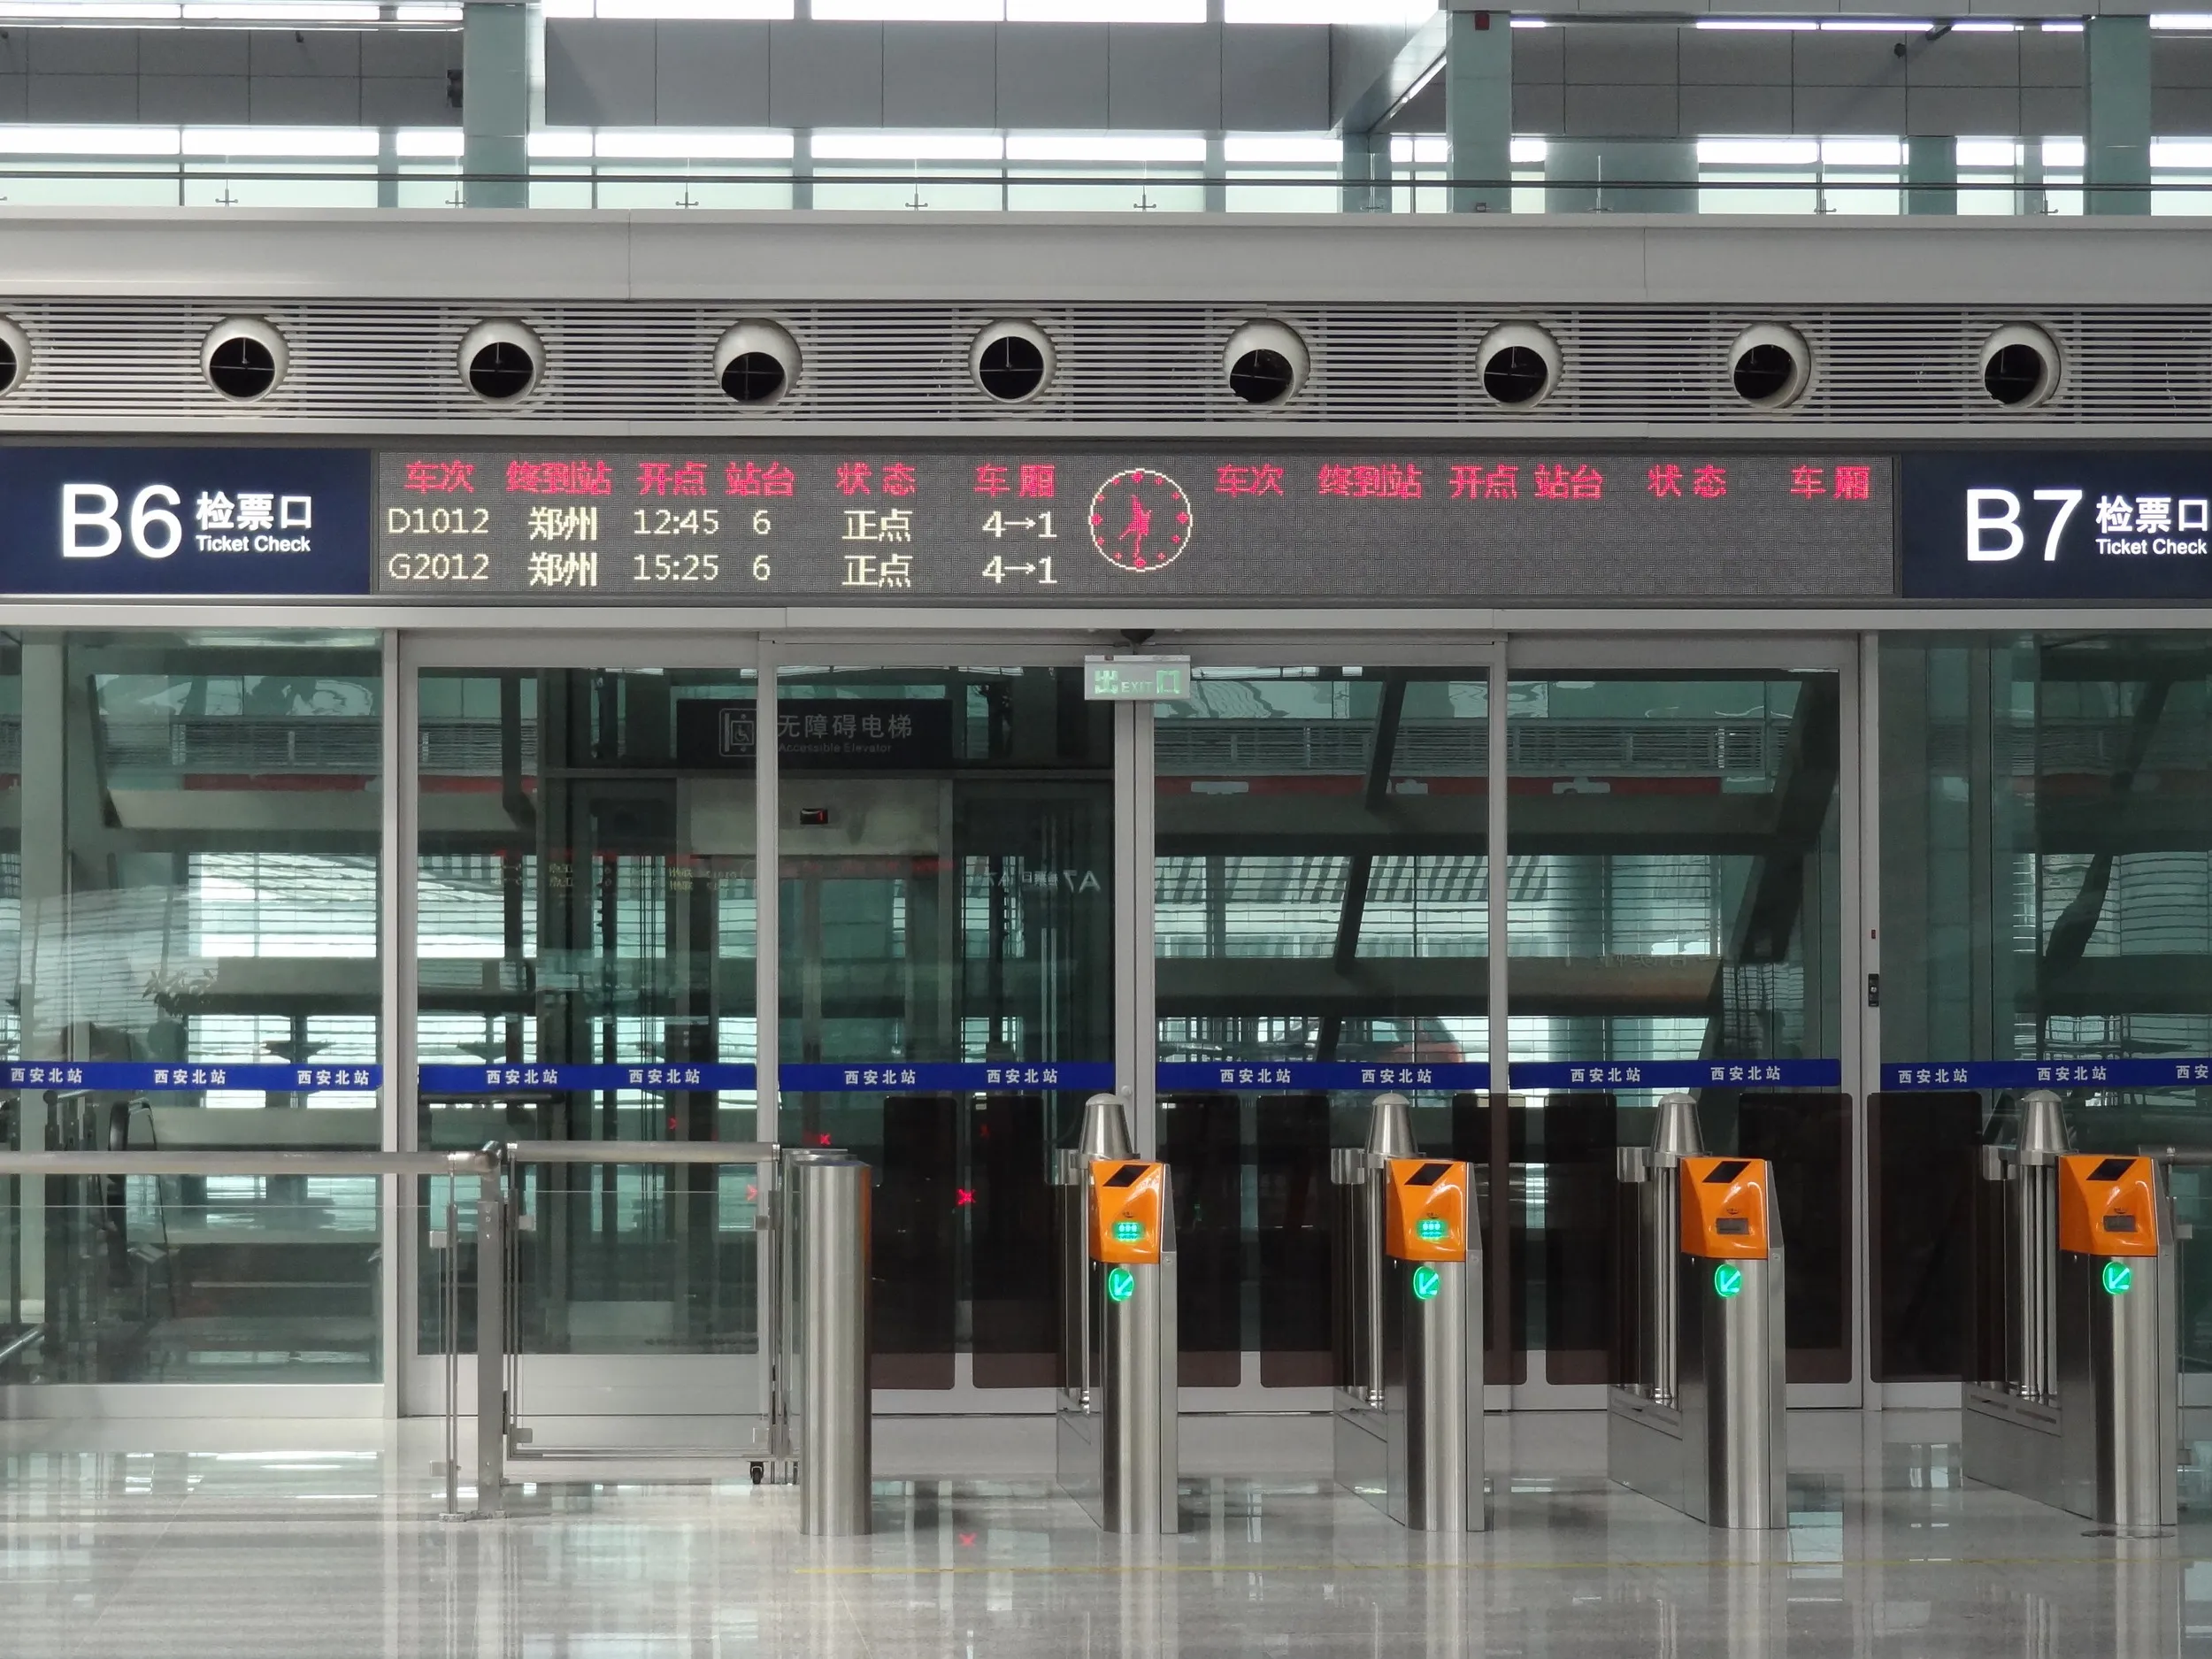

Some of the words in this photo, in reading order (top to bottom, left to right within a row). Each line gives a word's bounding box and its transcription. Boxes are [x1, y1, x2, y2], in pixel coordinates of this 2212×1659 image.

[405, 460, 474, 493] 车次
[506, 460, 612, 495] 终到站
[637, 461, 707, 496] 开点
[725, 462, 795, 496] 站台
[836, 462, 916, 496] 状态
[974, 464, 1055, 498] 车厢
[1216, 464, 1284, 496] 车次
[1317, 464, 1423, 499] 终到站
[1449, 464, 1518, 500] 开点
[1534, 465, 1603, 500] 站台
[1648, 464, 1727, 498] 状态
[1791, 465, 1870, 500] 车厢
[195, 490, 312, 532] 检票口
[2095, 495, 2208, 534] 检票口
[61, 483, 183, 559] B6
[387, 507, 489, 534] D1012
[527, 505, 598, 541] 郑州
[634, 509, 719, 535] 12:45
[752, 509, 772, 535] 6
[841, 509, 913, 542] 正点
[1965, 488, 2084, 563] B7
[195, 534, 250, 552] Ticket
[253, 534, 311, 552] Check
[2095, 538, 2148, 555] Ticket
[2152, 538, 2208, 555] Check
[387, 552, 489, 580] G2012
[527, 551, 598, 587] 郑州
[634, 553, 719, 580] 15:25
[752, 554, 771, 580] 6
[841, 553, 913, 588] 正点
[1120, 681, 1154, 694] EXIT
[778, 713, 913, 740] 无障碍电梯
[778, 742, 841, 754] Accessible
[843, 742, 893, 754] Elevator
[11, 1067, 83, 1084] 西安北站
[153, 1068, 227, 1086] 西安北站
[296, 1069, 370, 1087] 西安北站
[486, 1069, 558, 1085] 西安北站
[628, 1068, 701, 1084] 西安北站
[844, 1069, 916, 1085] 西安北站
[987, 1068, 1058, 1084] 西安北站
[1219, 1068, 1291, 1084] 西安北站
[1361, 1068, 1432, 1084] 西安北站
[1570, 1067, 1641, 1083] 西安北站
[1710, 1065, 1781, 1081] 西安北站
[1898, 1068, 1968, 1084] 西安北站
[2037, 1065, 2107, 1081] 西安北站
[2176, 1064, 2209, 1079] 西安
